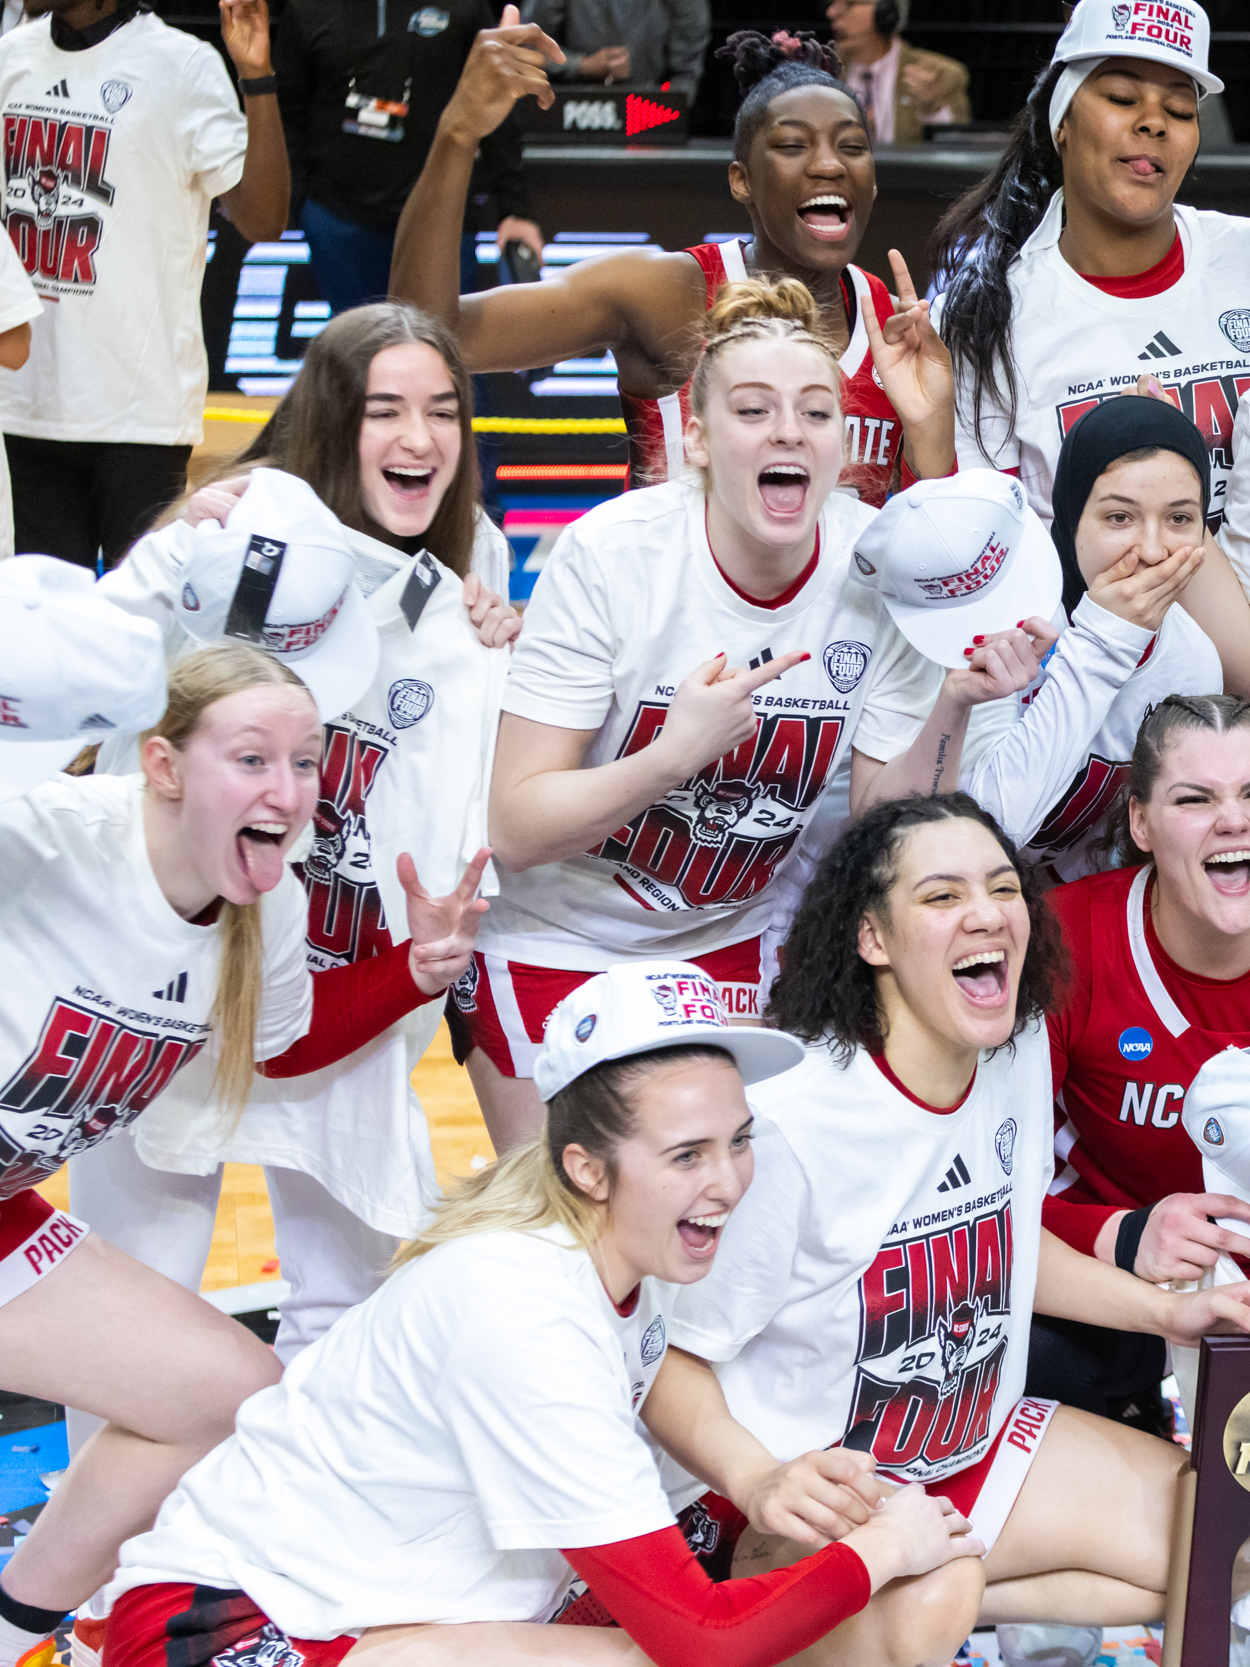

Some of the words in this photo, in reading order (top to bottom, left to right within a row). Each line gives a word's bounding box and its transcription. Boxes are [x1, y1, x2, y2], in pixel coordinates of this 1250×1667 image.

[1133, 2, 1194, 31] FINAL
[1130, 22, 1192, 51] FOUR
[25, 104, 59, 115] WOMEN'S
[59, 109, 115, 126] BASKETBALL
[563, 100, 623, 130] POSS.
[3, 113, 116, 207] FINAL
[60, 194, 84, 208] 24
[2, 208, 104, 285] OUR
[1068, 380, 1105, 396] NCAA
[1110, 370, 1172, 386] WOMN'S
[941, 541, 1001, 587] FINAL
[947, 547, 1005, 596] FOUR
[832, 663, 861, 676] FOUR
[834, 652, 862, 664] FINAL
[765, 695, 851, 711] BASKETBALL
[752, 809, 794, 829] 24
[638, 877, 680, 912] REGION
[721, 987, 759, 1014] ACK
[116, 1006, 163, 1026] WOMEN'S
[1122, 1042, 1151, 1053] NCAA
[1118, 1081, 1186, 1129] NC
[912, 1205, 963, 1230] WOMEN'S
[964, 1181, 1013, 1214] BASKETBALL
[23, 1212, 84, 1276] PACK
[854, 1198, 1013, 1366] FINAL
[898, 1352, 935, 1374] 20
[976, 1323, 1003, 1347] 24
[841, 1334, 1009, 1468] FOUR
[1006, 1398, 1052, 1455] PACK
